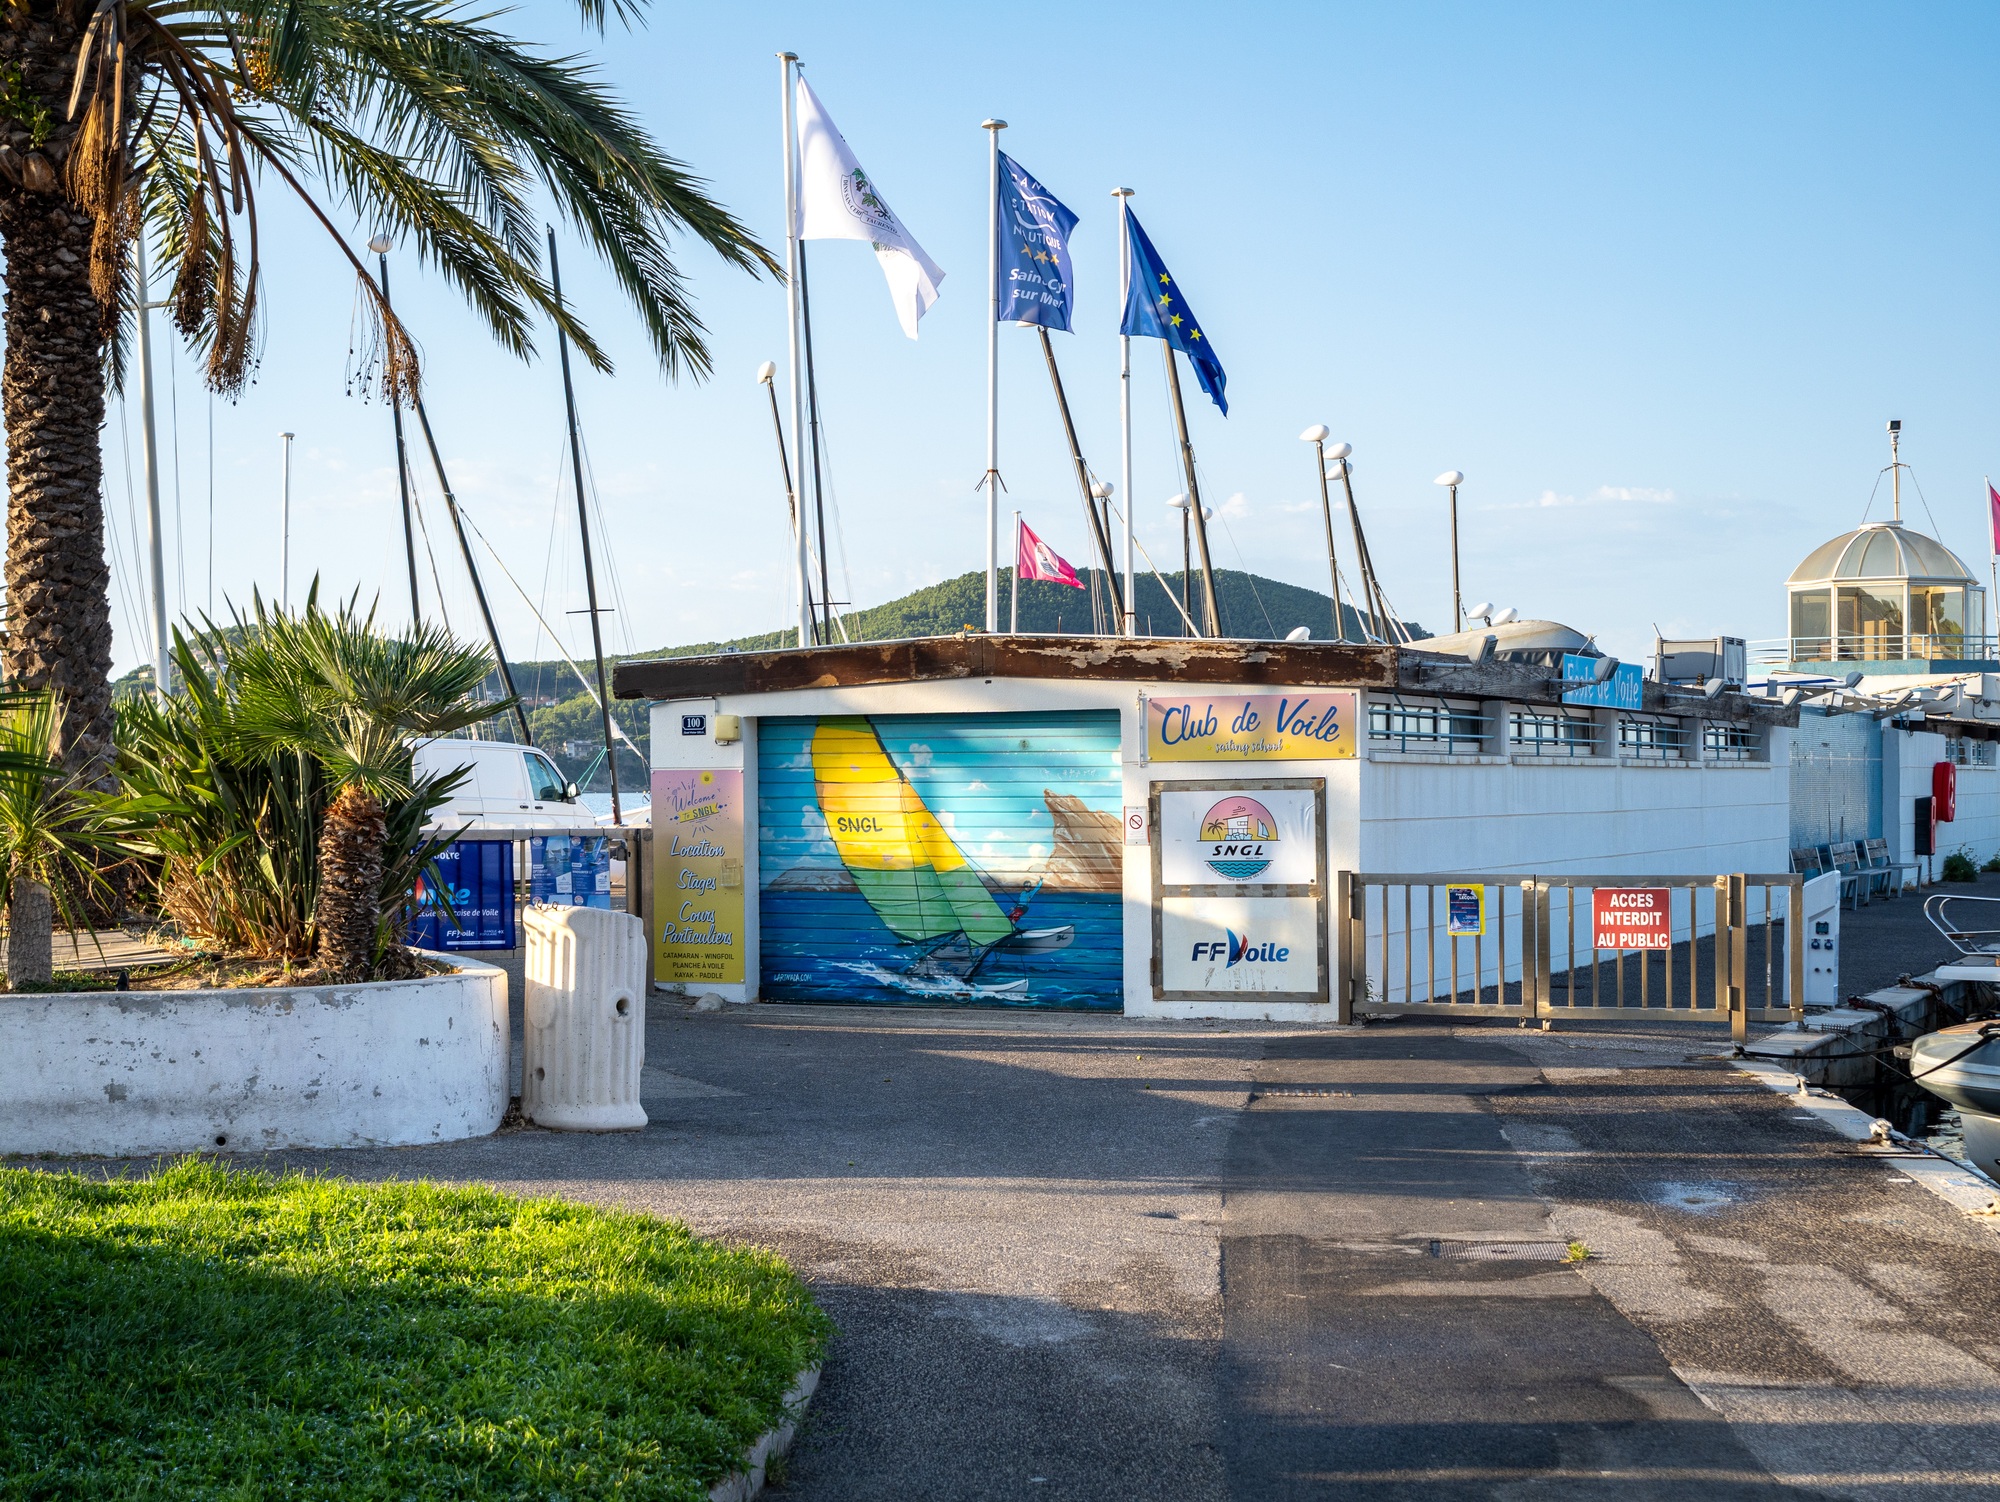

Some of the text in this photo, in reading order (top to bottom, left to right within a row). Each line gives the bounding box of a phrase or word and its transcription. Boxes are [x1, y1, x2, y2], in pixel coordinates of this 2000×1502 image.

[1012, 288, 1064, 308] sur Mer
[1614, 670, 1639, 702] Voile
[687, 718, 700, 727] 100
[1161, 698, 1340, 746] Club de Voile
[1215, 738, 1283, 756] sailing school
[672, 790, 716, 812] Welcome
[692, 805, 714, 818] SNGL
[837, 817, 883, 832] SNGL
[670, 836, 725, 857] Location
[1212, 845, 1264, 856] SNGL
[676, 868, 716, 896] Stages
[679, 900, 715, 922] Cours
[1610, 894, 1654, 908] ACCES
[1600, 912, 1662, 925] INTERDIT
[662, 922, 732, 945] Particuliers
[1597, 933, 1668, 947] AU PUBLIC
[1192, 927, 1290, 969] FFVoile
